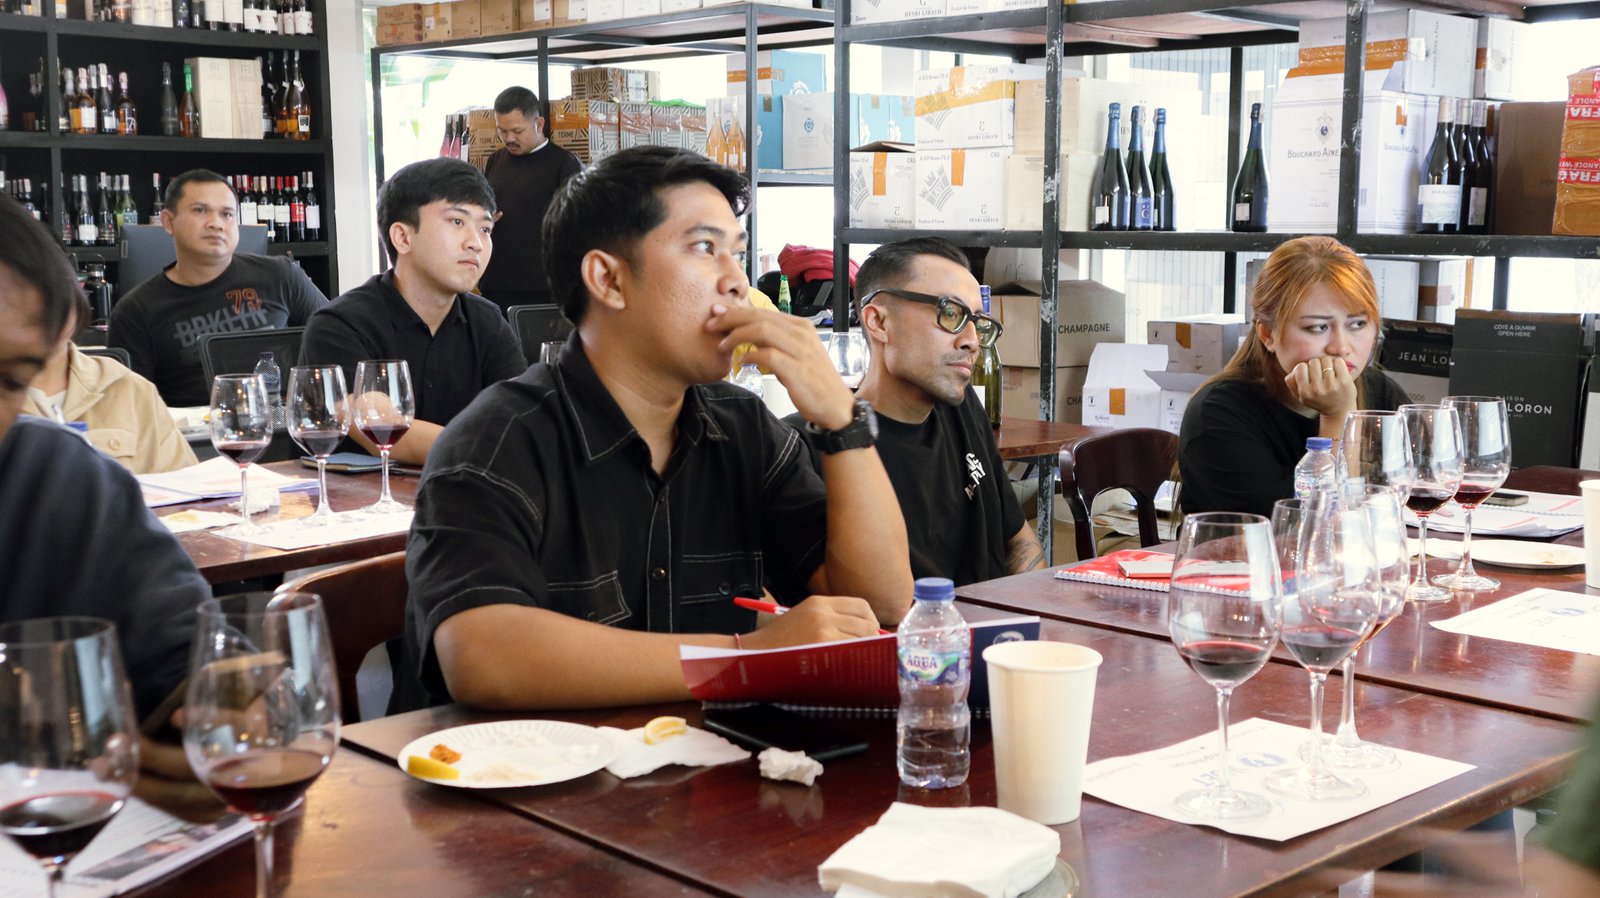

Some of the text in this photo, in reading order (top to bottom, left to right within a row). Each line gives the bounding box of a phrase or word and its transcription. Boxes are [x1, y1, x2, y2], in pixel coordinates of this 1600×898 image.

[1566, 107, 1600, 118] FRA
[1287, 150, 1321, 159] BOUCHARD
[1574, 161, 1600, 169] ANDLE
[226, 287, 262, 315] 79
[1058, 322, 1110, 334] CHAMPAGNE
[1398, 352, 1426, 363] JEAN
[1507, 403, 1553, 415] LORON
[906, 654, 938, 670] AQUA
